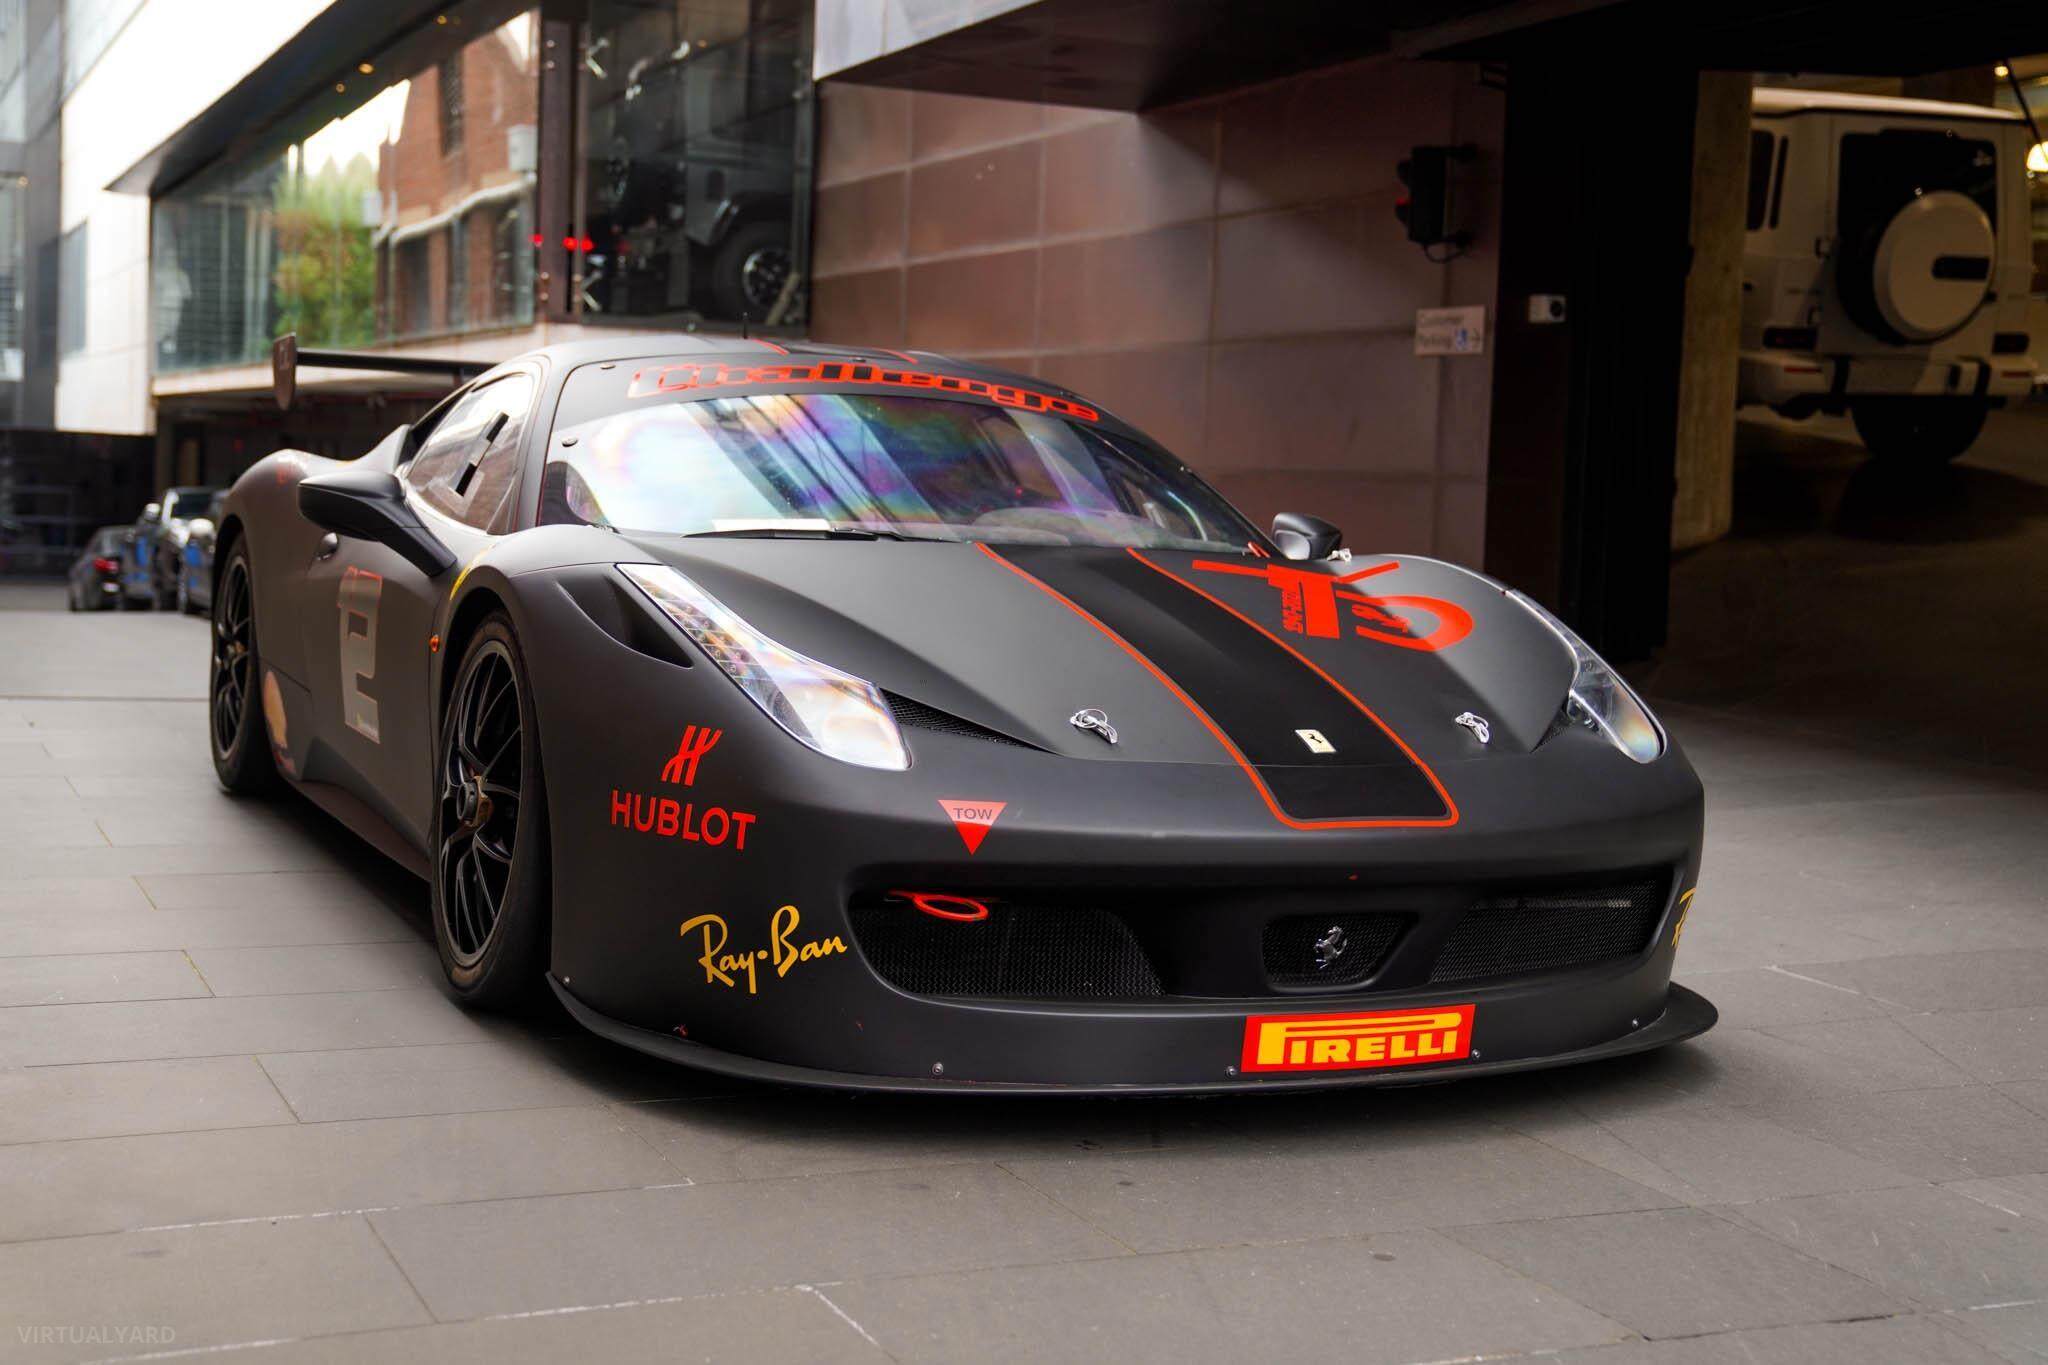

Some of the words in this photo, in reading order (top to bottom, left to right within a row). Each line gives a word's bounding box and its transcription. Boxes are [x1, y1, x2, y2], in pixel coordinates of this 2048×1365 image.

[627, 362, 1099, 422] Challenge
[610, 789, 757, 851] HUBLOT
[952, 807, 993, 820] TOW
[1256, 1012, 1462, 1066] PIRELLI
